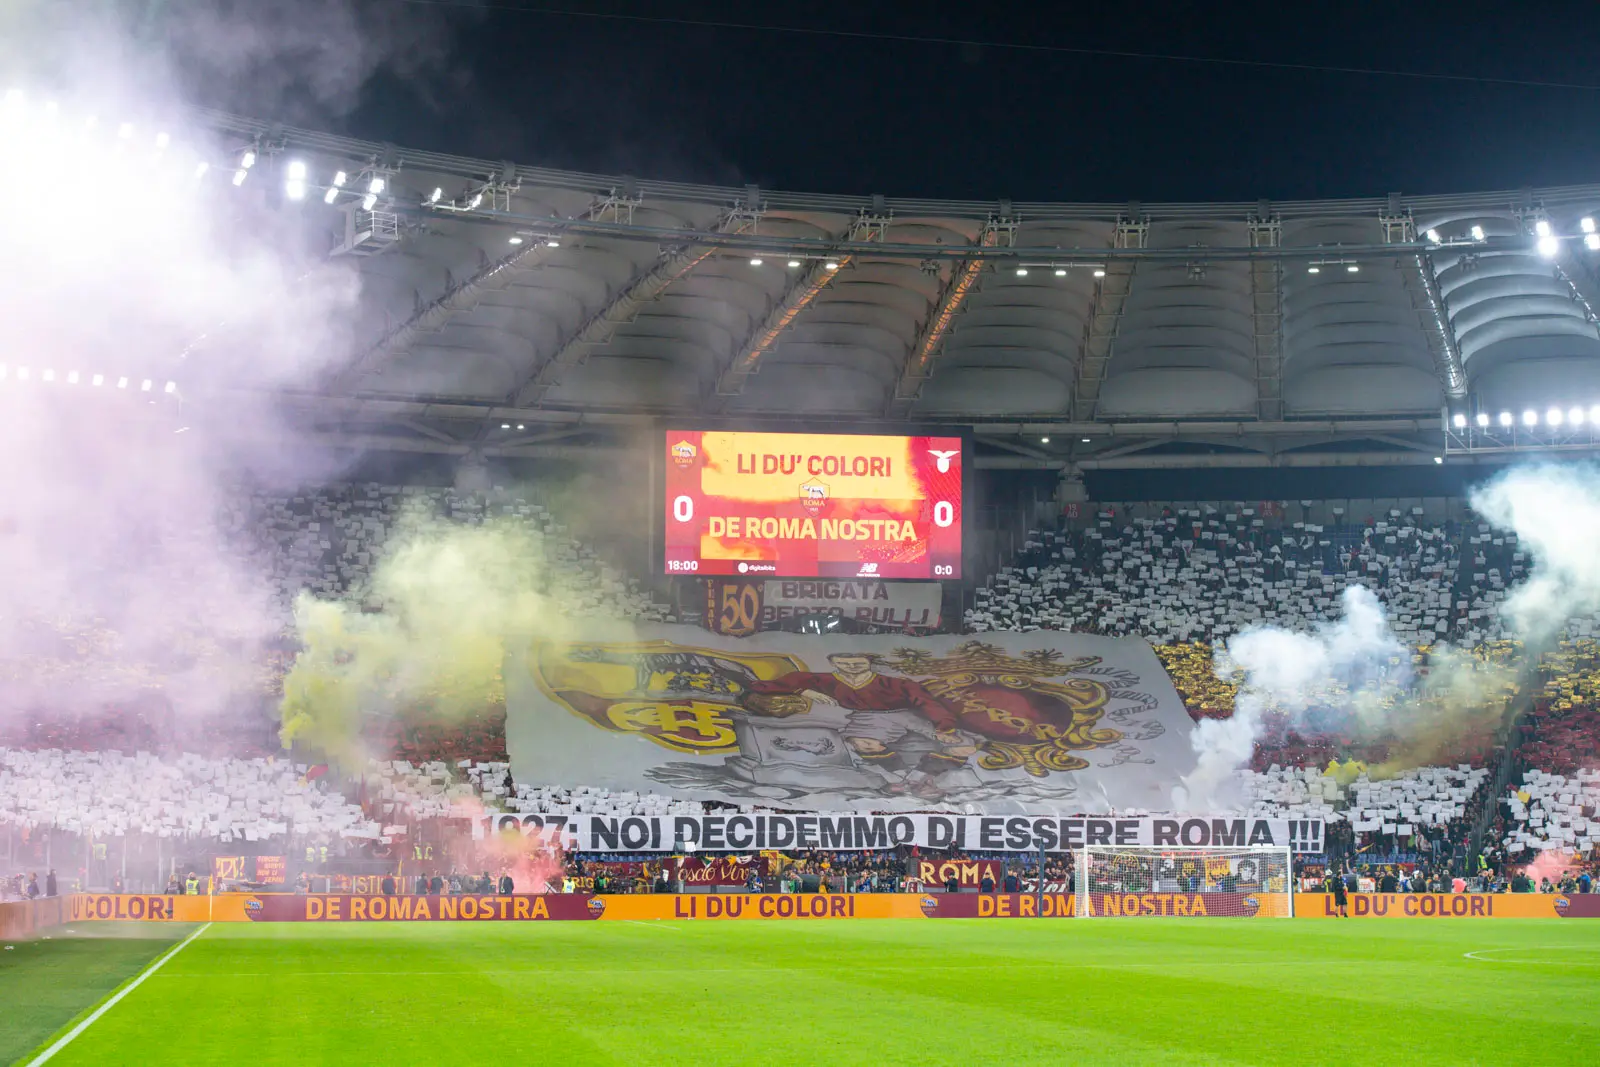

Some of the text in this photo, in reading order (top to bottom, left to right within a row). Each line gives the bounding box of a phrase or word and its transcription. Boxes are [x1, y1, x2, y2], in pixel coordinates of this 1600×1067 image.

[737, 454, 892, 477] LI DU' COLORI
[673, 495, 694, 523] 0
[933, 500, 954, 527] 0
[709, 516, 917, 542] DE ROMA NOSTRA
[667, 560, 698, 571] 18:00
[934, 565, 953, 575] 0:0
[781, 581, 890, 600] BRIGATA
[590, 816, 661, 849] NOI
[674, 815, 915, 849] DECIDEMMO
[928, 816, 967, 847] DI
[979, 817, 1141, 850] ESSERE
[1153, 818, 1275, 849] ROMA
[305, 897, 549, 920] DE ROMA NOSTRA
[674, 896, 855, 917] LI DU' COLORI
[978, 895, 1207, 917] DE ROMA NOSTRA
[1354, 895, 1395, 917] DU'
[1403, 895, 1493, 916] COLORI
